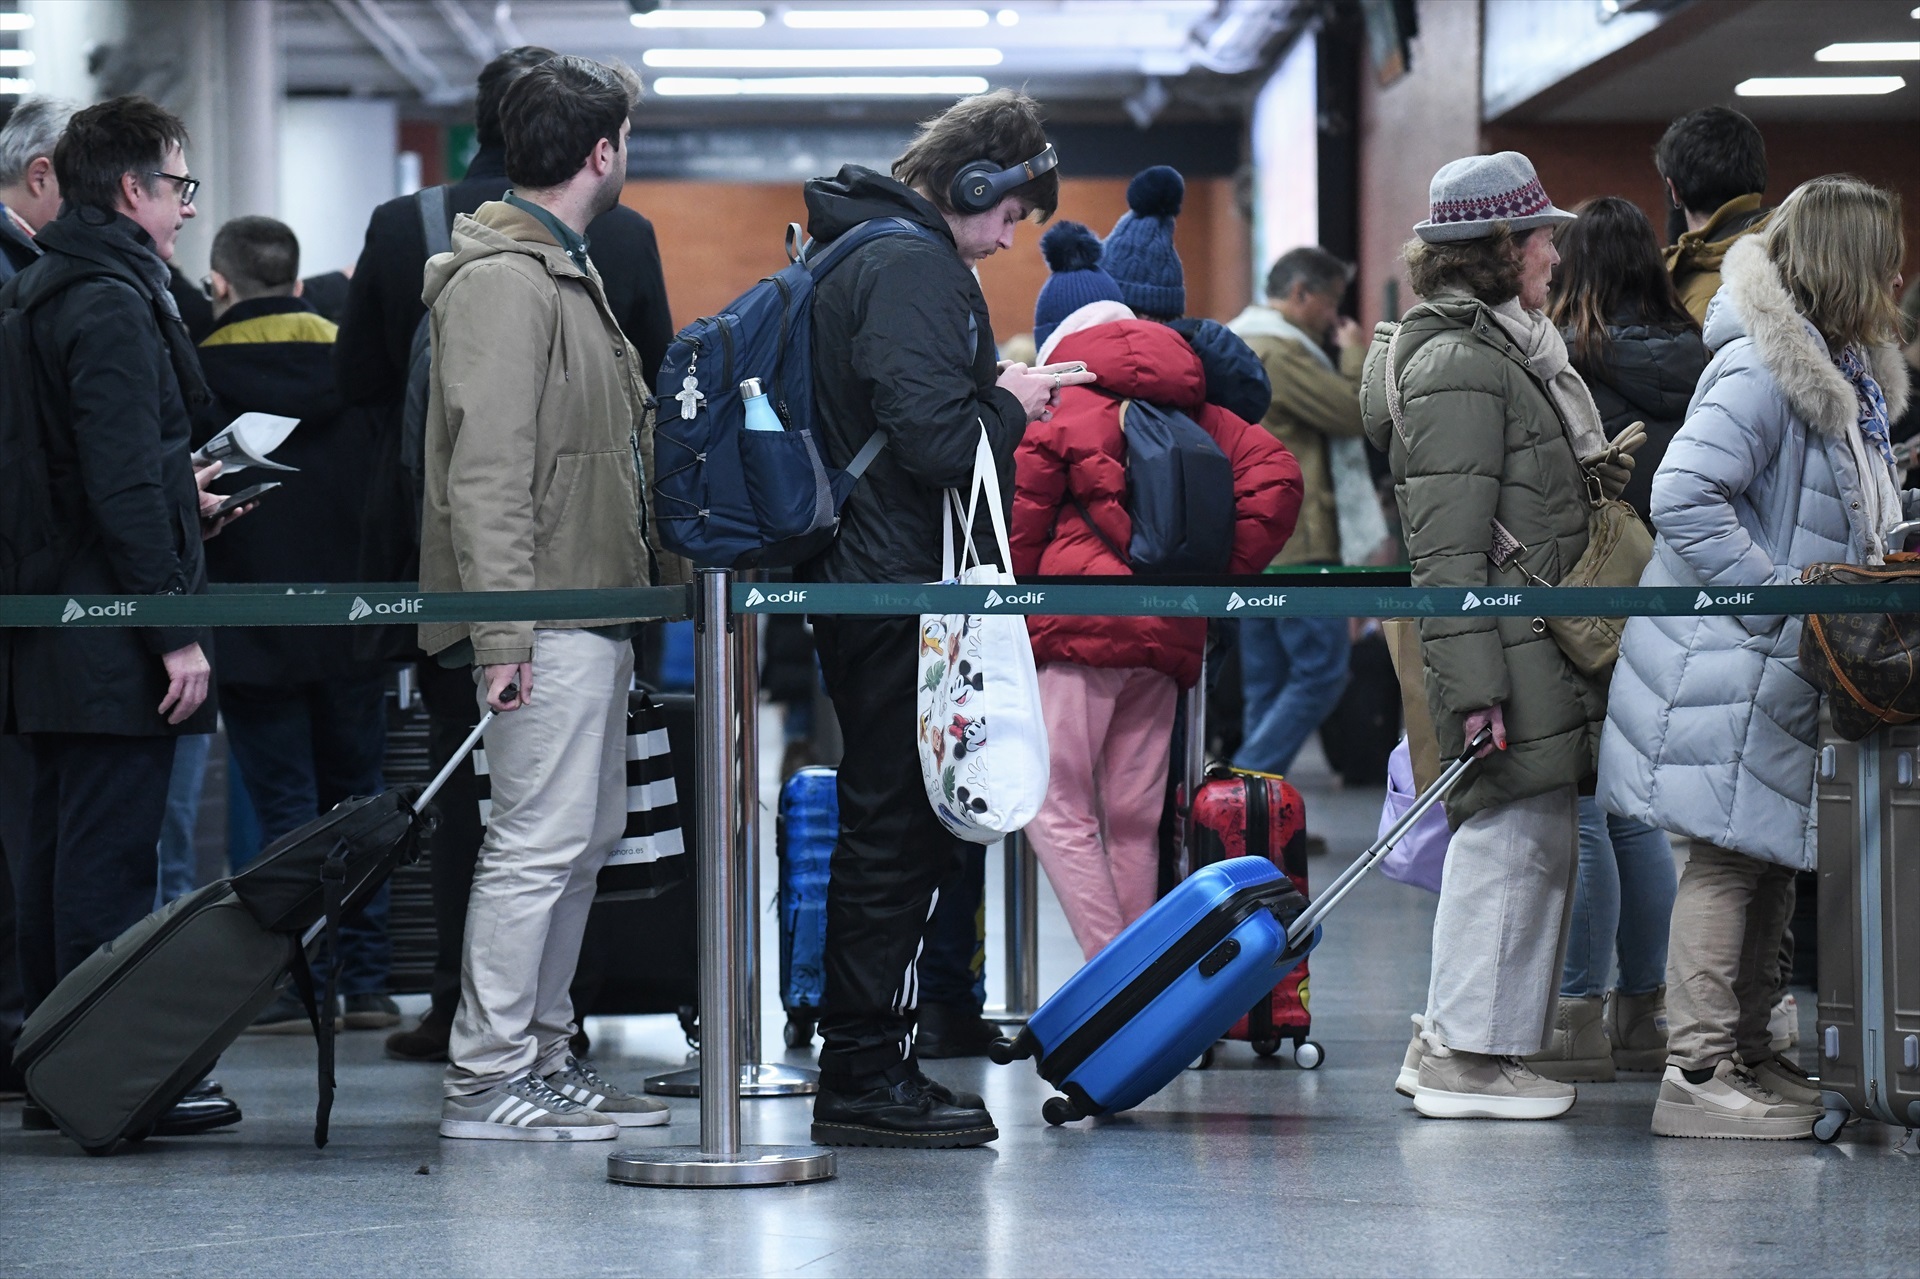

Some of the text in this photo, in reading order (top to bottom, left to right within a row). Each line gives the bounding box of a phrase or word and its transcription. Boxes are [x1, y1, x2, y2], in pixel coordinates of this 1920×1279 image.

[767, 591, 808, 603] adif
[1006, 591, 1046, 604] adif
[1248, 594, 1287, 607] adif
[1483, 593, 1522, 606] adif
[1716, 592, 1755, 605] adif
[88, 600, 137, 617] adif
[375, 598, 423, 614] adif
[608, 848, 644, 859] phora.es
